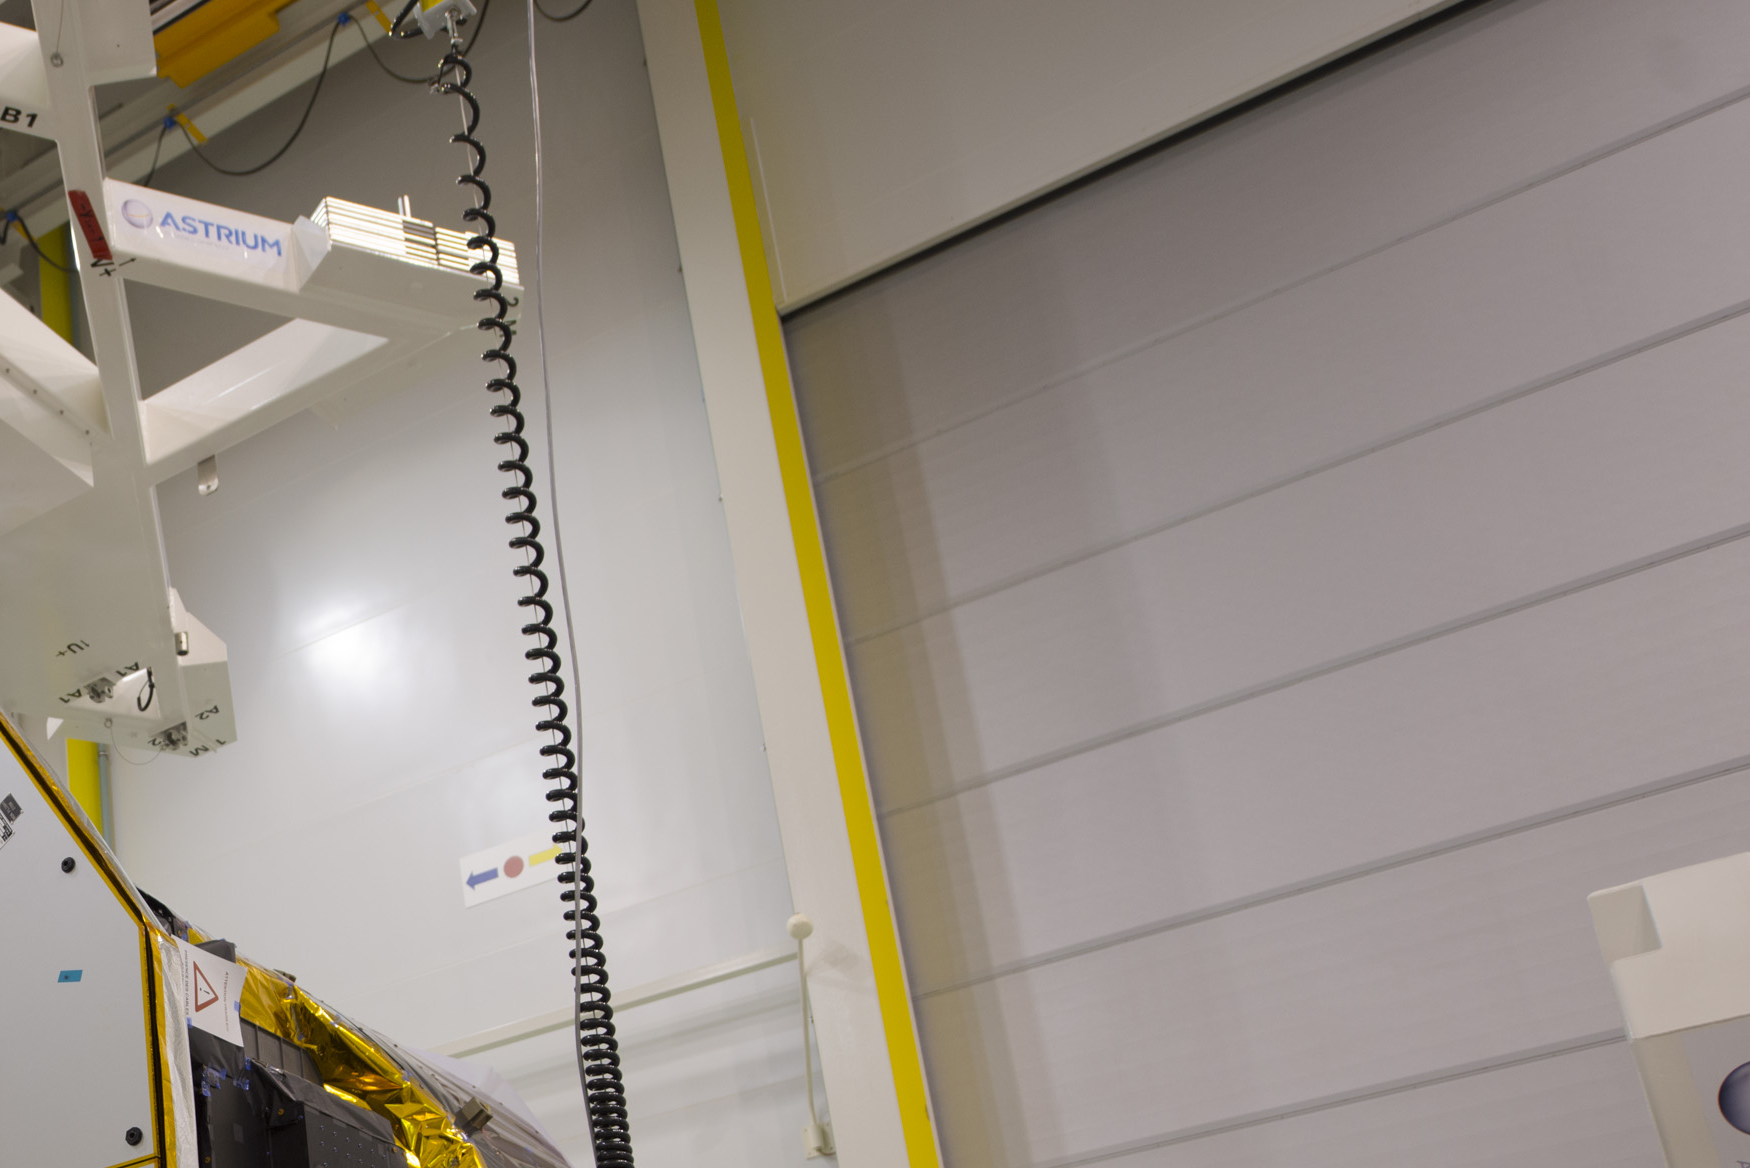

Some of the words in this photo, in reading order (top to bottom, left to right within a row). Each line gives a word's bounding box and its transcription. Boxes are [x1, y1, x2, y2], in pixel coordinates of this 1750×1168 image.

[0, 106, 38, 128] B1
[159, 210, 283, 257] ASTRIUM
[115, 661, 140, 678] A1
[58, 688, 83, 704] A1
[194, 704, 220, 720] A2
